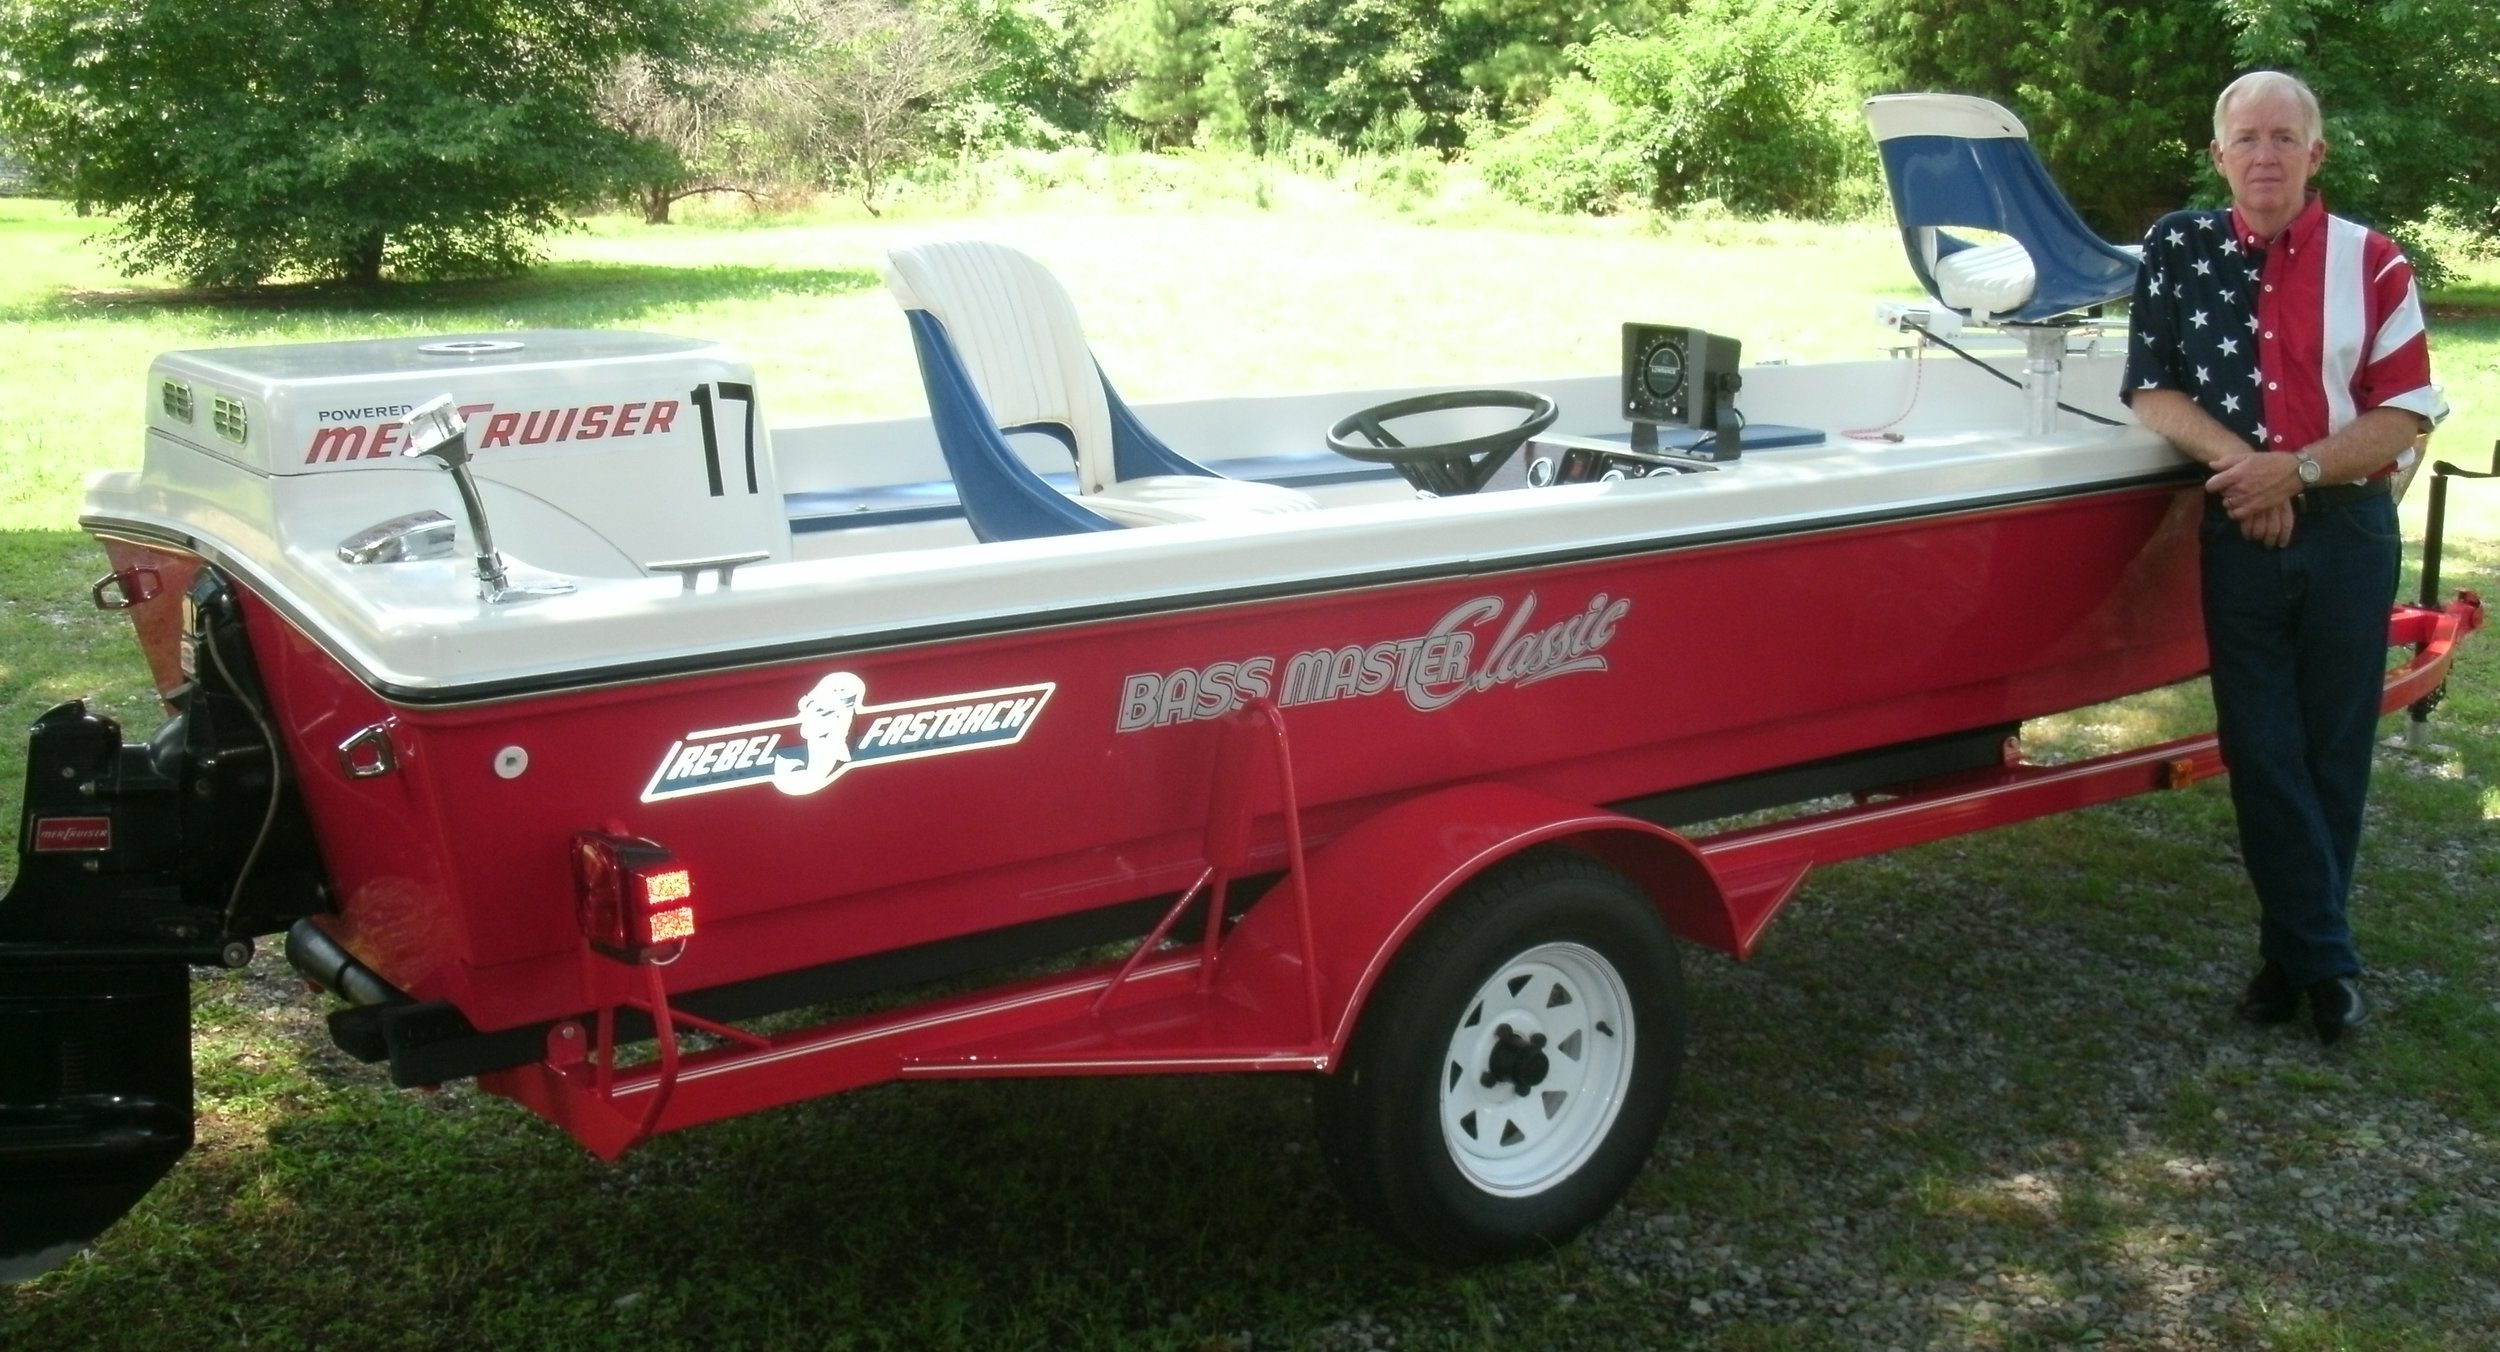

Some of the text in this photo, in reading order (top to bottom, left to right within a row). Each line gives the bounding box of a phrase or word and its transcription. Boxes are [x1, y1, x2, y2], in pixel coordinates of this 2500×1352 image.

[305, 401, 679, 464] MERUISER
[318, 404, 413, 421] POWERED
[691, 381, 758, 497] 17
[1116, 590, 1631, 733] BASS MASTER Classic
[667, 697, 1035, 780] REBEL FASTBACK
